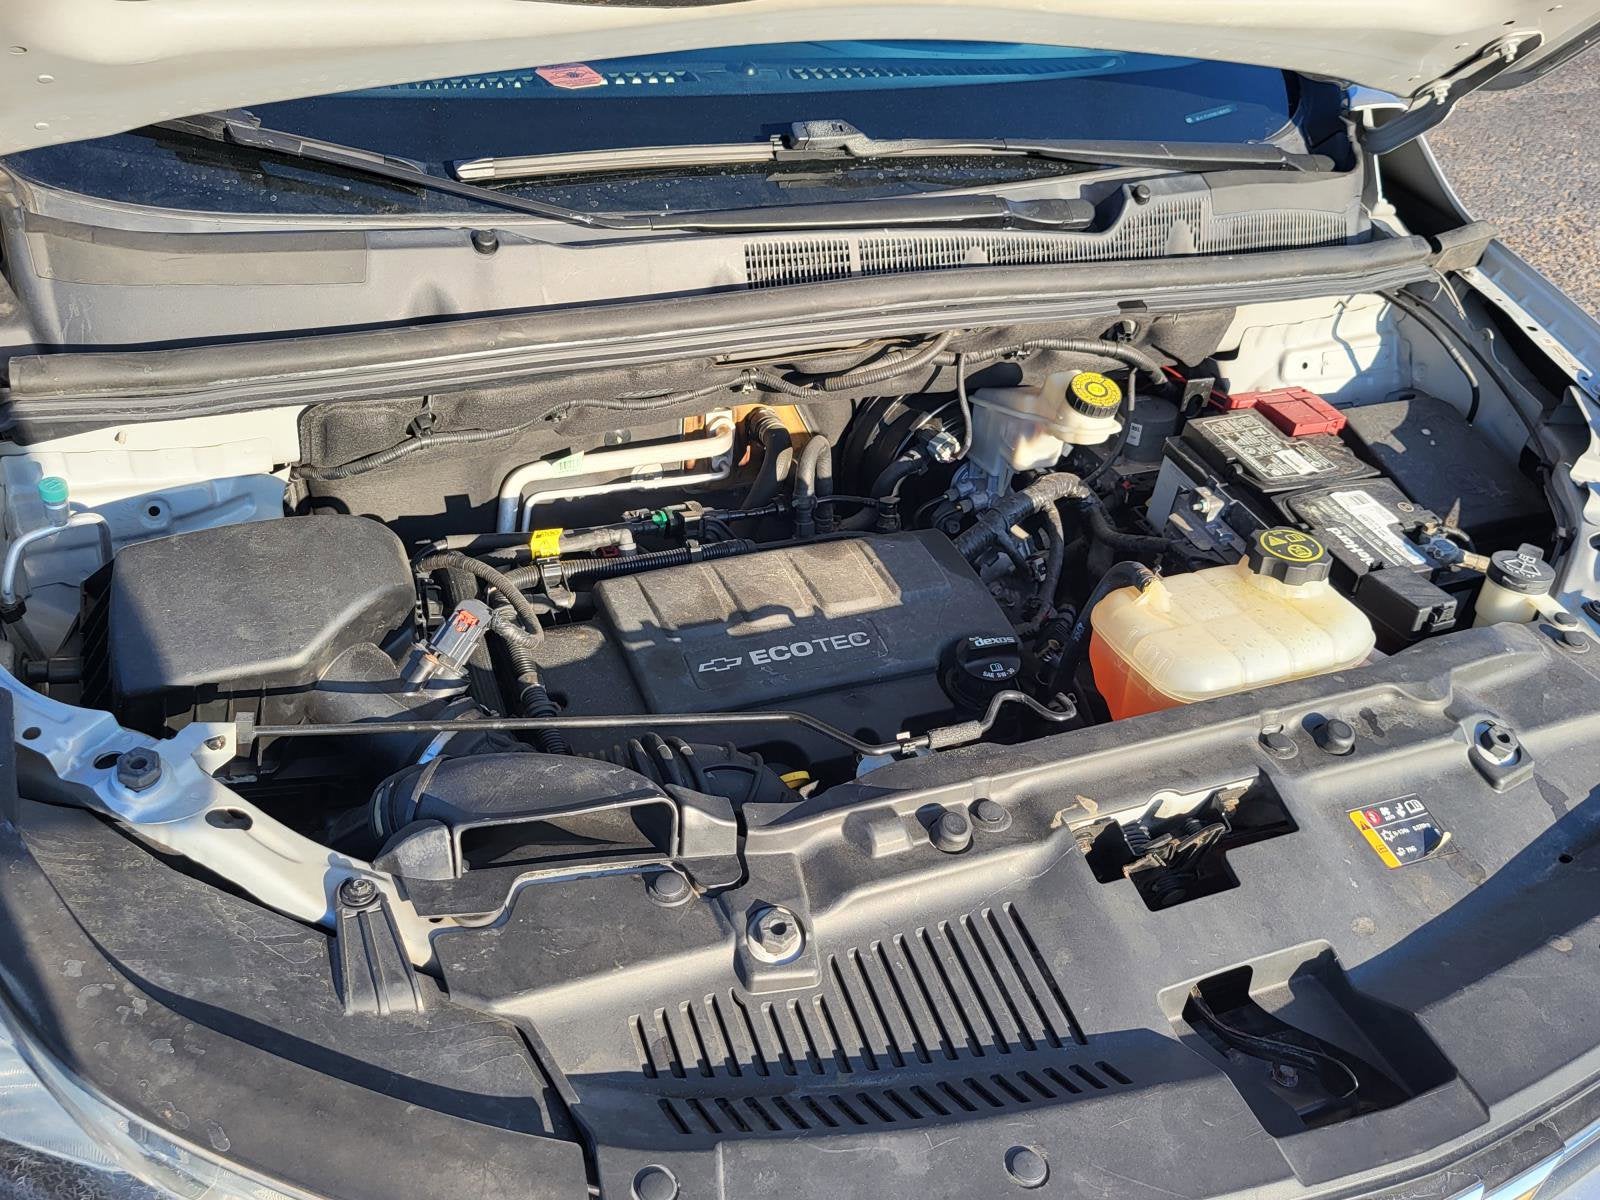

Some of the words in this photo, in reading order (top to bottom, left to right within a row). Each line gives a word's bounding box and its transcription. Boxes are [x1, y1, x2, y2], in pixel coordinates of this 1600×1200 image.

[974, 636, 1015, 647] dexos
[748, 631, 871, 665] ECOTEC
[982, 670, 995, 678] SAE
